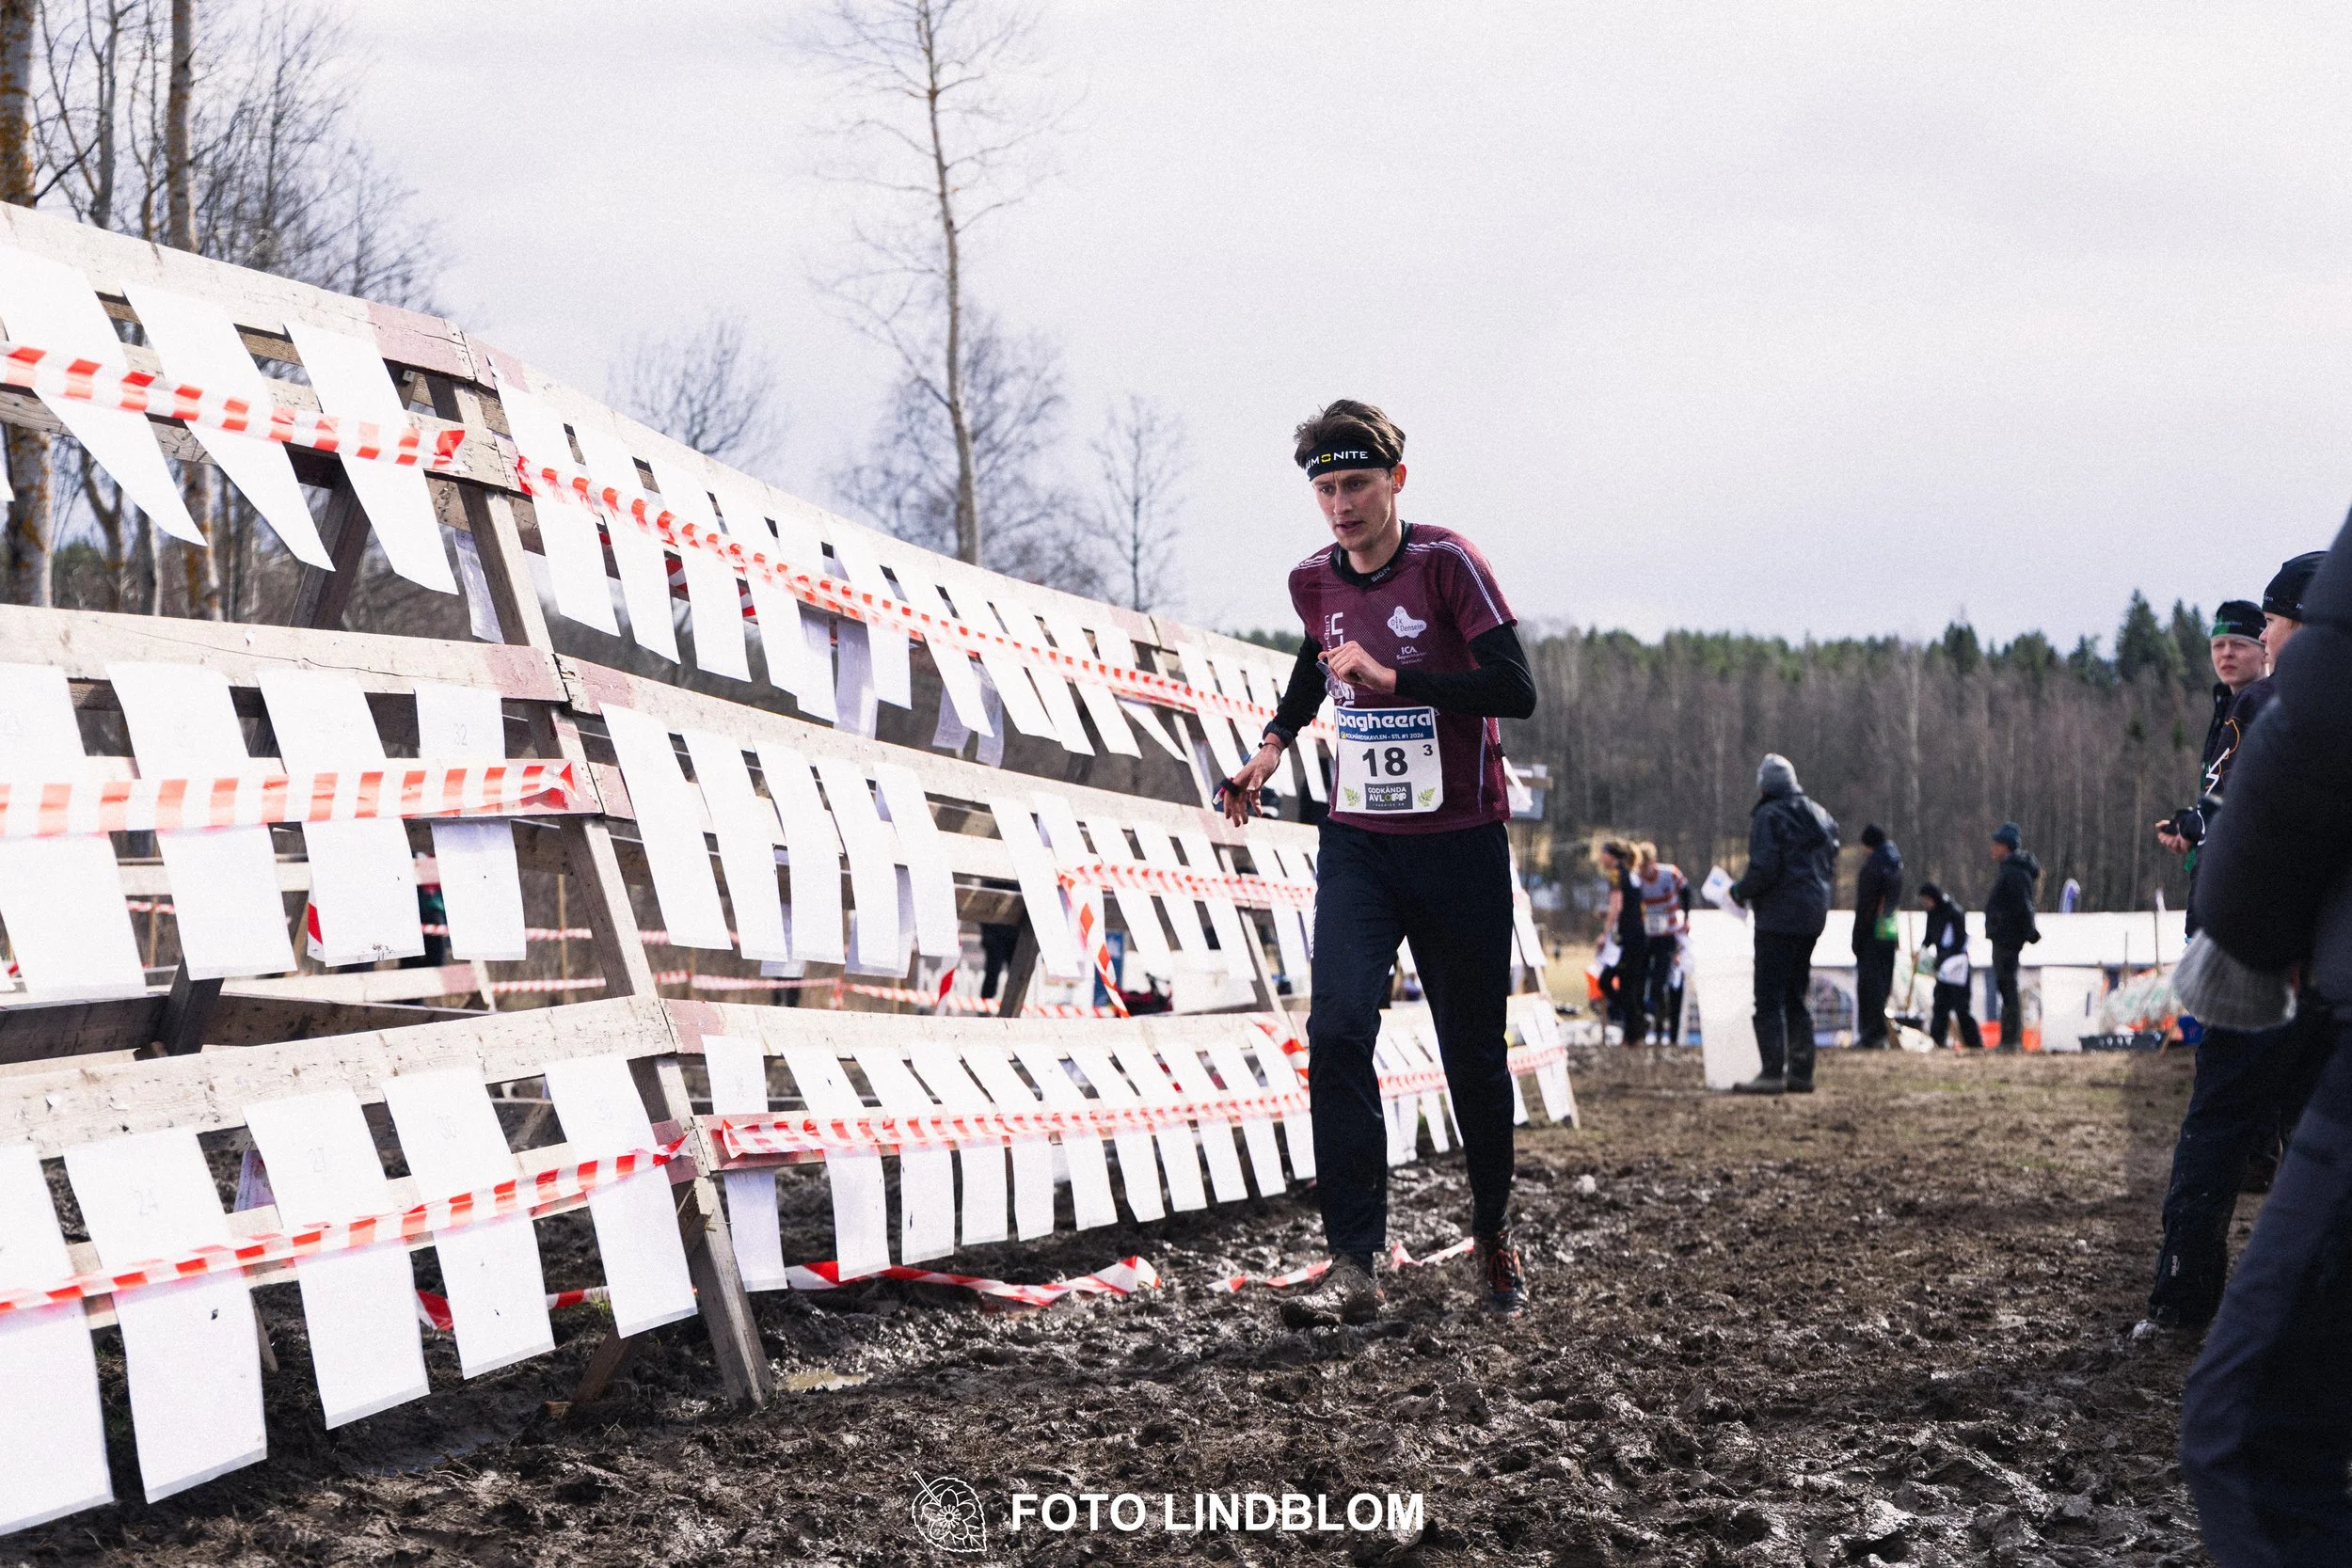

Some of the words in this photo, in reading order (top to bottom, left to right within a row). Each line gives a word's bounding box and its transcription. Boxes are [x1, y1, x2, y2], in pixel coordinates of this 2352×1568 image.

[1401, 646, 1417, 655] ICA
[1338, 710, 1431, 732] bagheera
[1362, 747, 1408, 777] 18
[1422, 744, 1433, 756] 3
